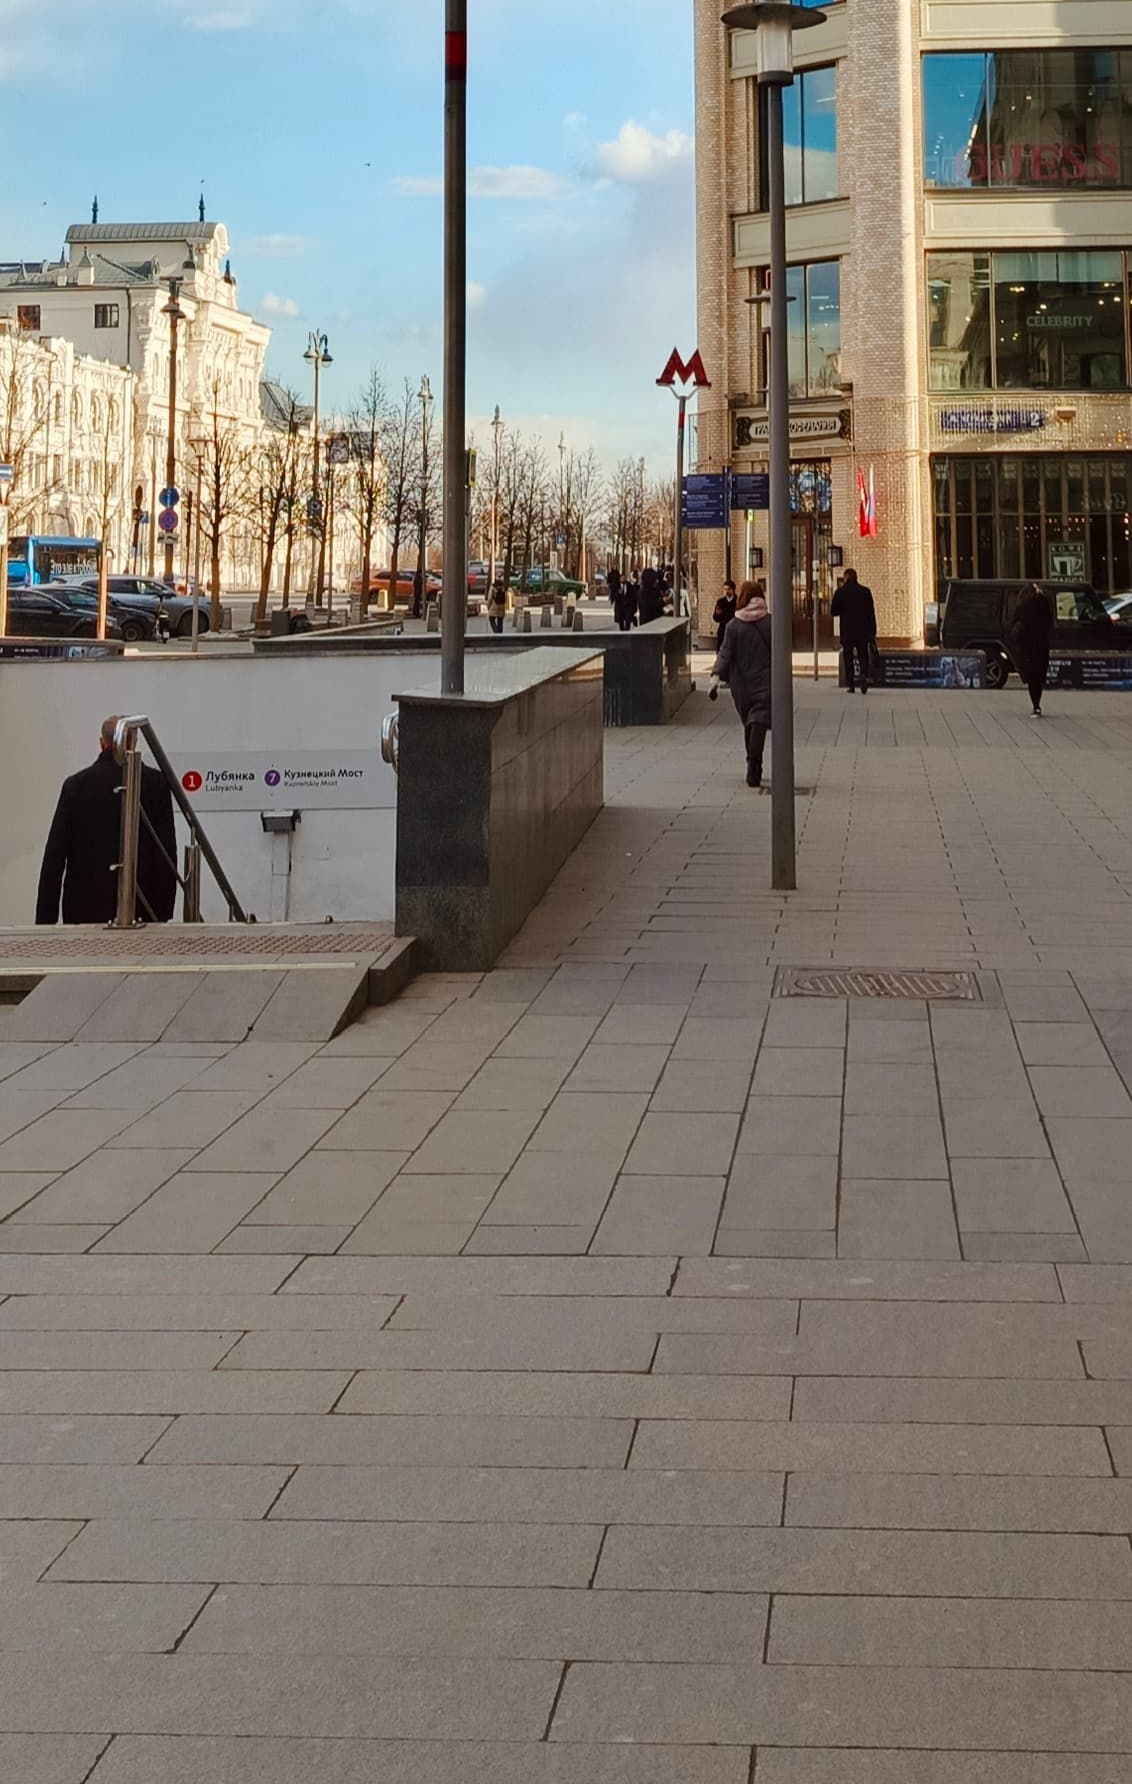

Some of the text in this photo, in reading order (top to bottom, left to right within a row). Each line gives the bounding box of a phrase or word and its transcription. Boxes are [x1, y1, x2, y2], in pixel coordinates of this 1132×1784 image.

[956, 144, 1119, 181] GUESS
[1026, 316, 1094, 328] CELEBRITY
[205, 771, 255, 782] Лубянка
[284, 769, 336, 779] Кузнецкий
[338, 769, 364, 778] Мост
[205, 784, 243, 793] Lubyanka
